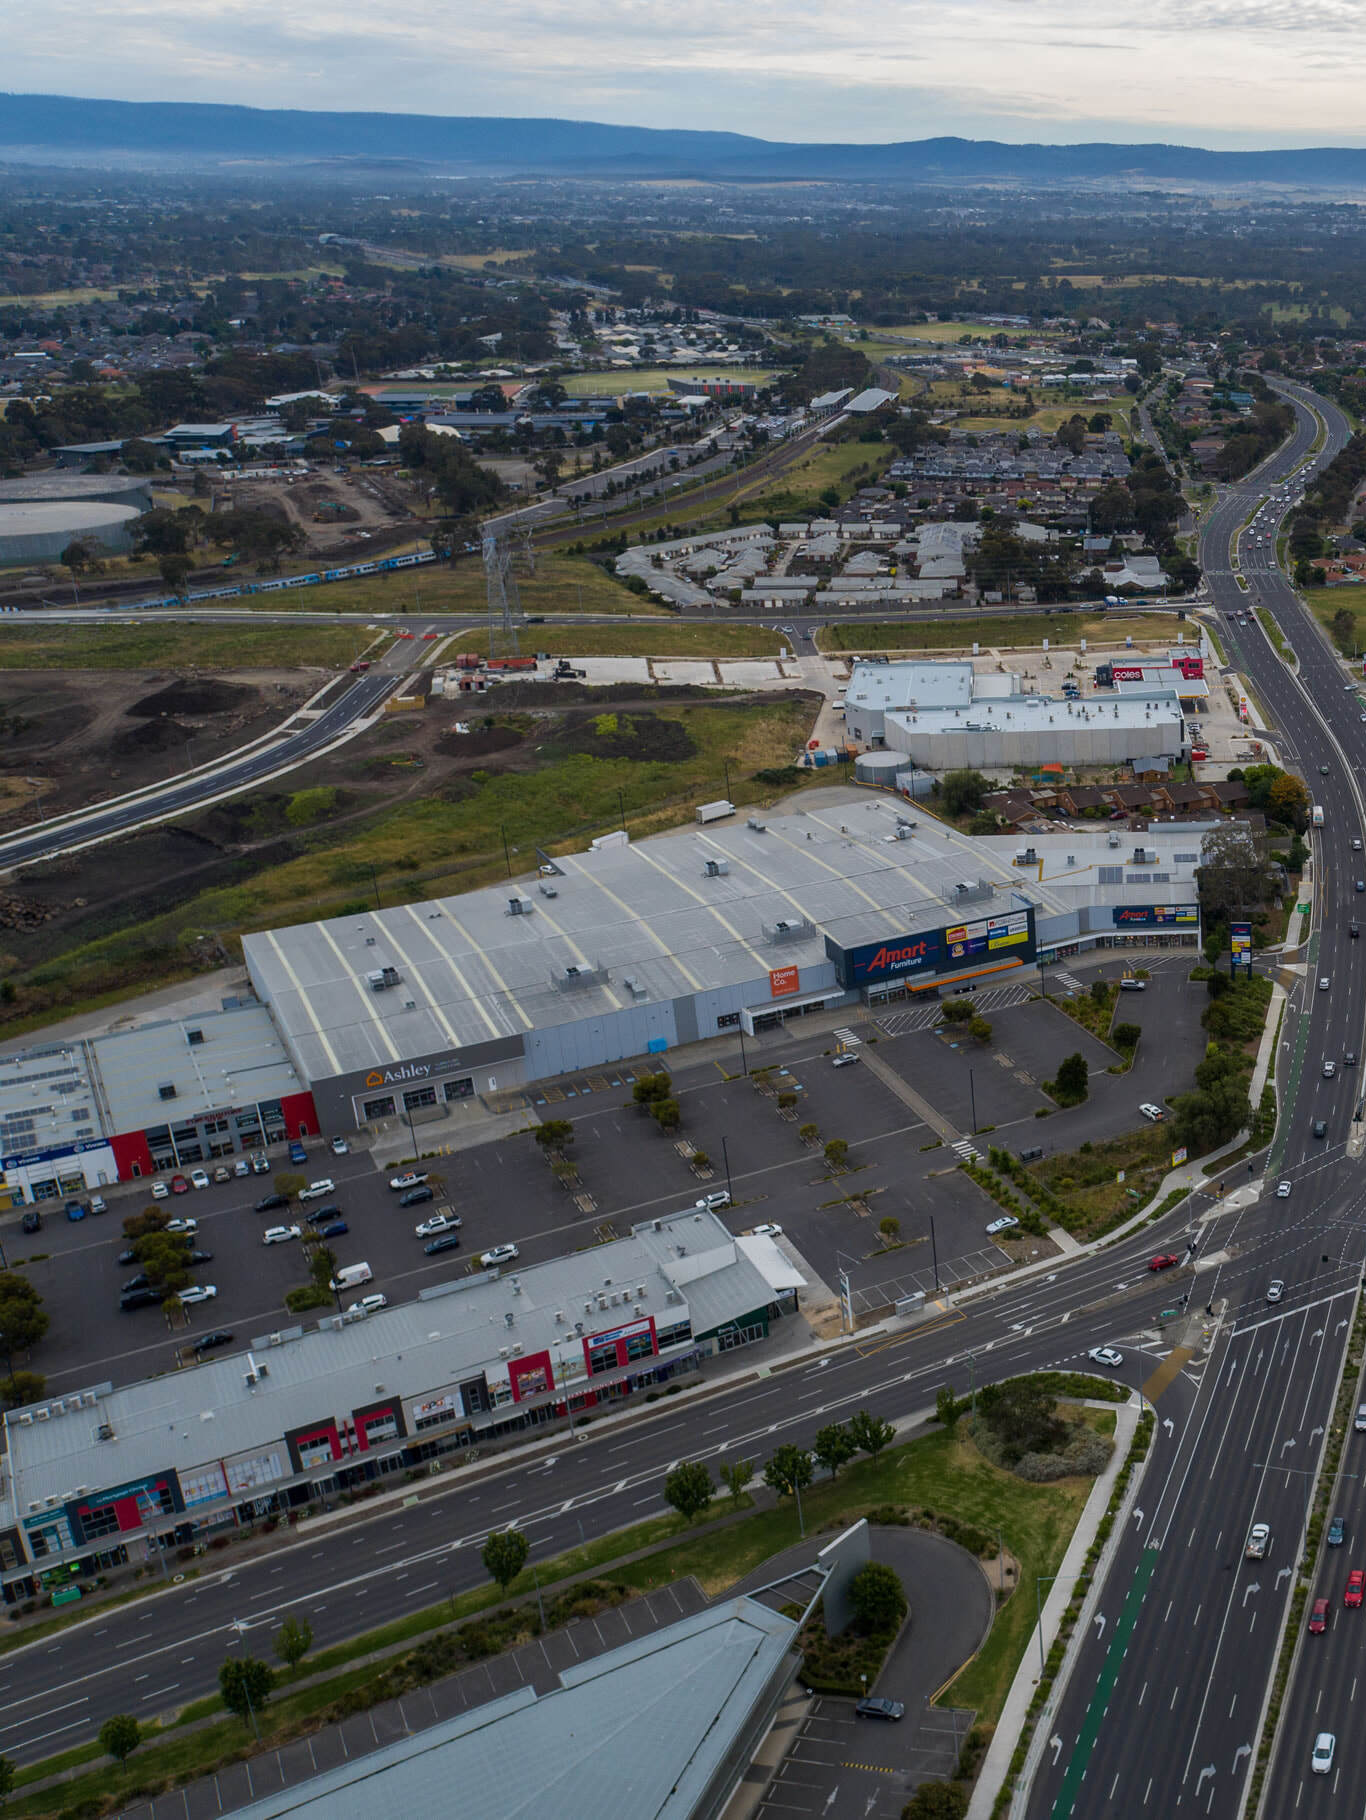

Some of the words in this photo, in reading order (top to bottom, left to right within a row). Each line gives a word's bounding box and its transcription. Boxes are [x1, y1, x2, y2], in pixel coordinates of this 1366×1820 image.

[1114, 671, 1141, 679] coles
[866, 941, 927, 972] Amart
[890, 957, 922, 970] Furniture
[773, 970, 795, 979] Home
[383, 1063, 431, 1083] Ashley
